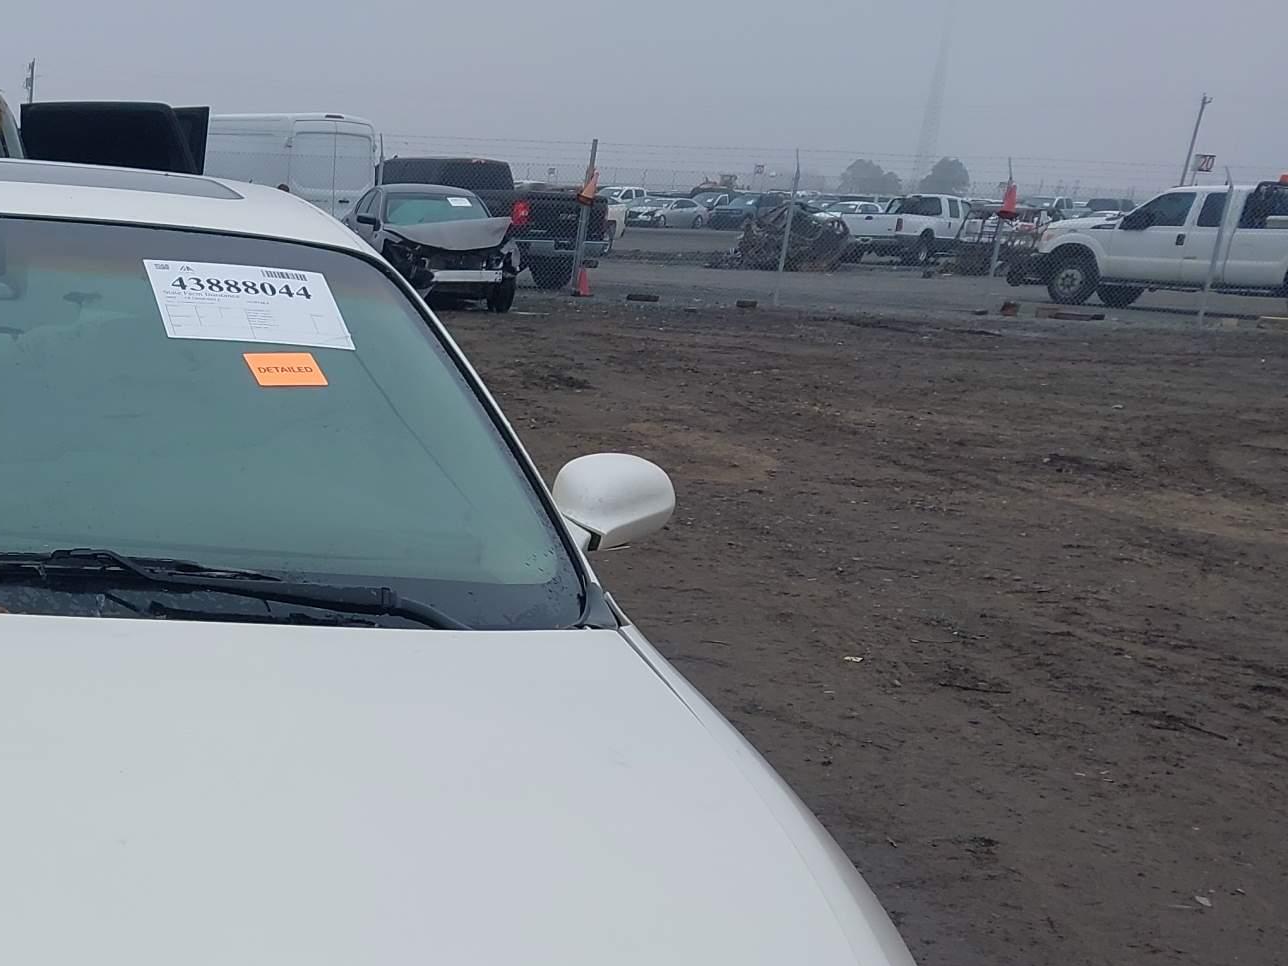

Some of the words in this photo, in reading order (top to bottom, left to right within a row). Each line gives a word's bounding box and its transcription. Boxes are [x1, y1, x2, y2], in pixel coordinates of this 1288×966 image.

[1198, 155, 1215, 170] 20
[171, 276, 312, 300] 43888044
[257, 366, 313, 374] DETAILED
